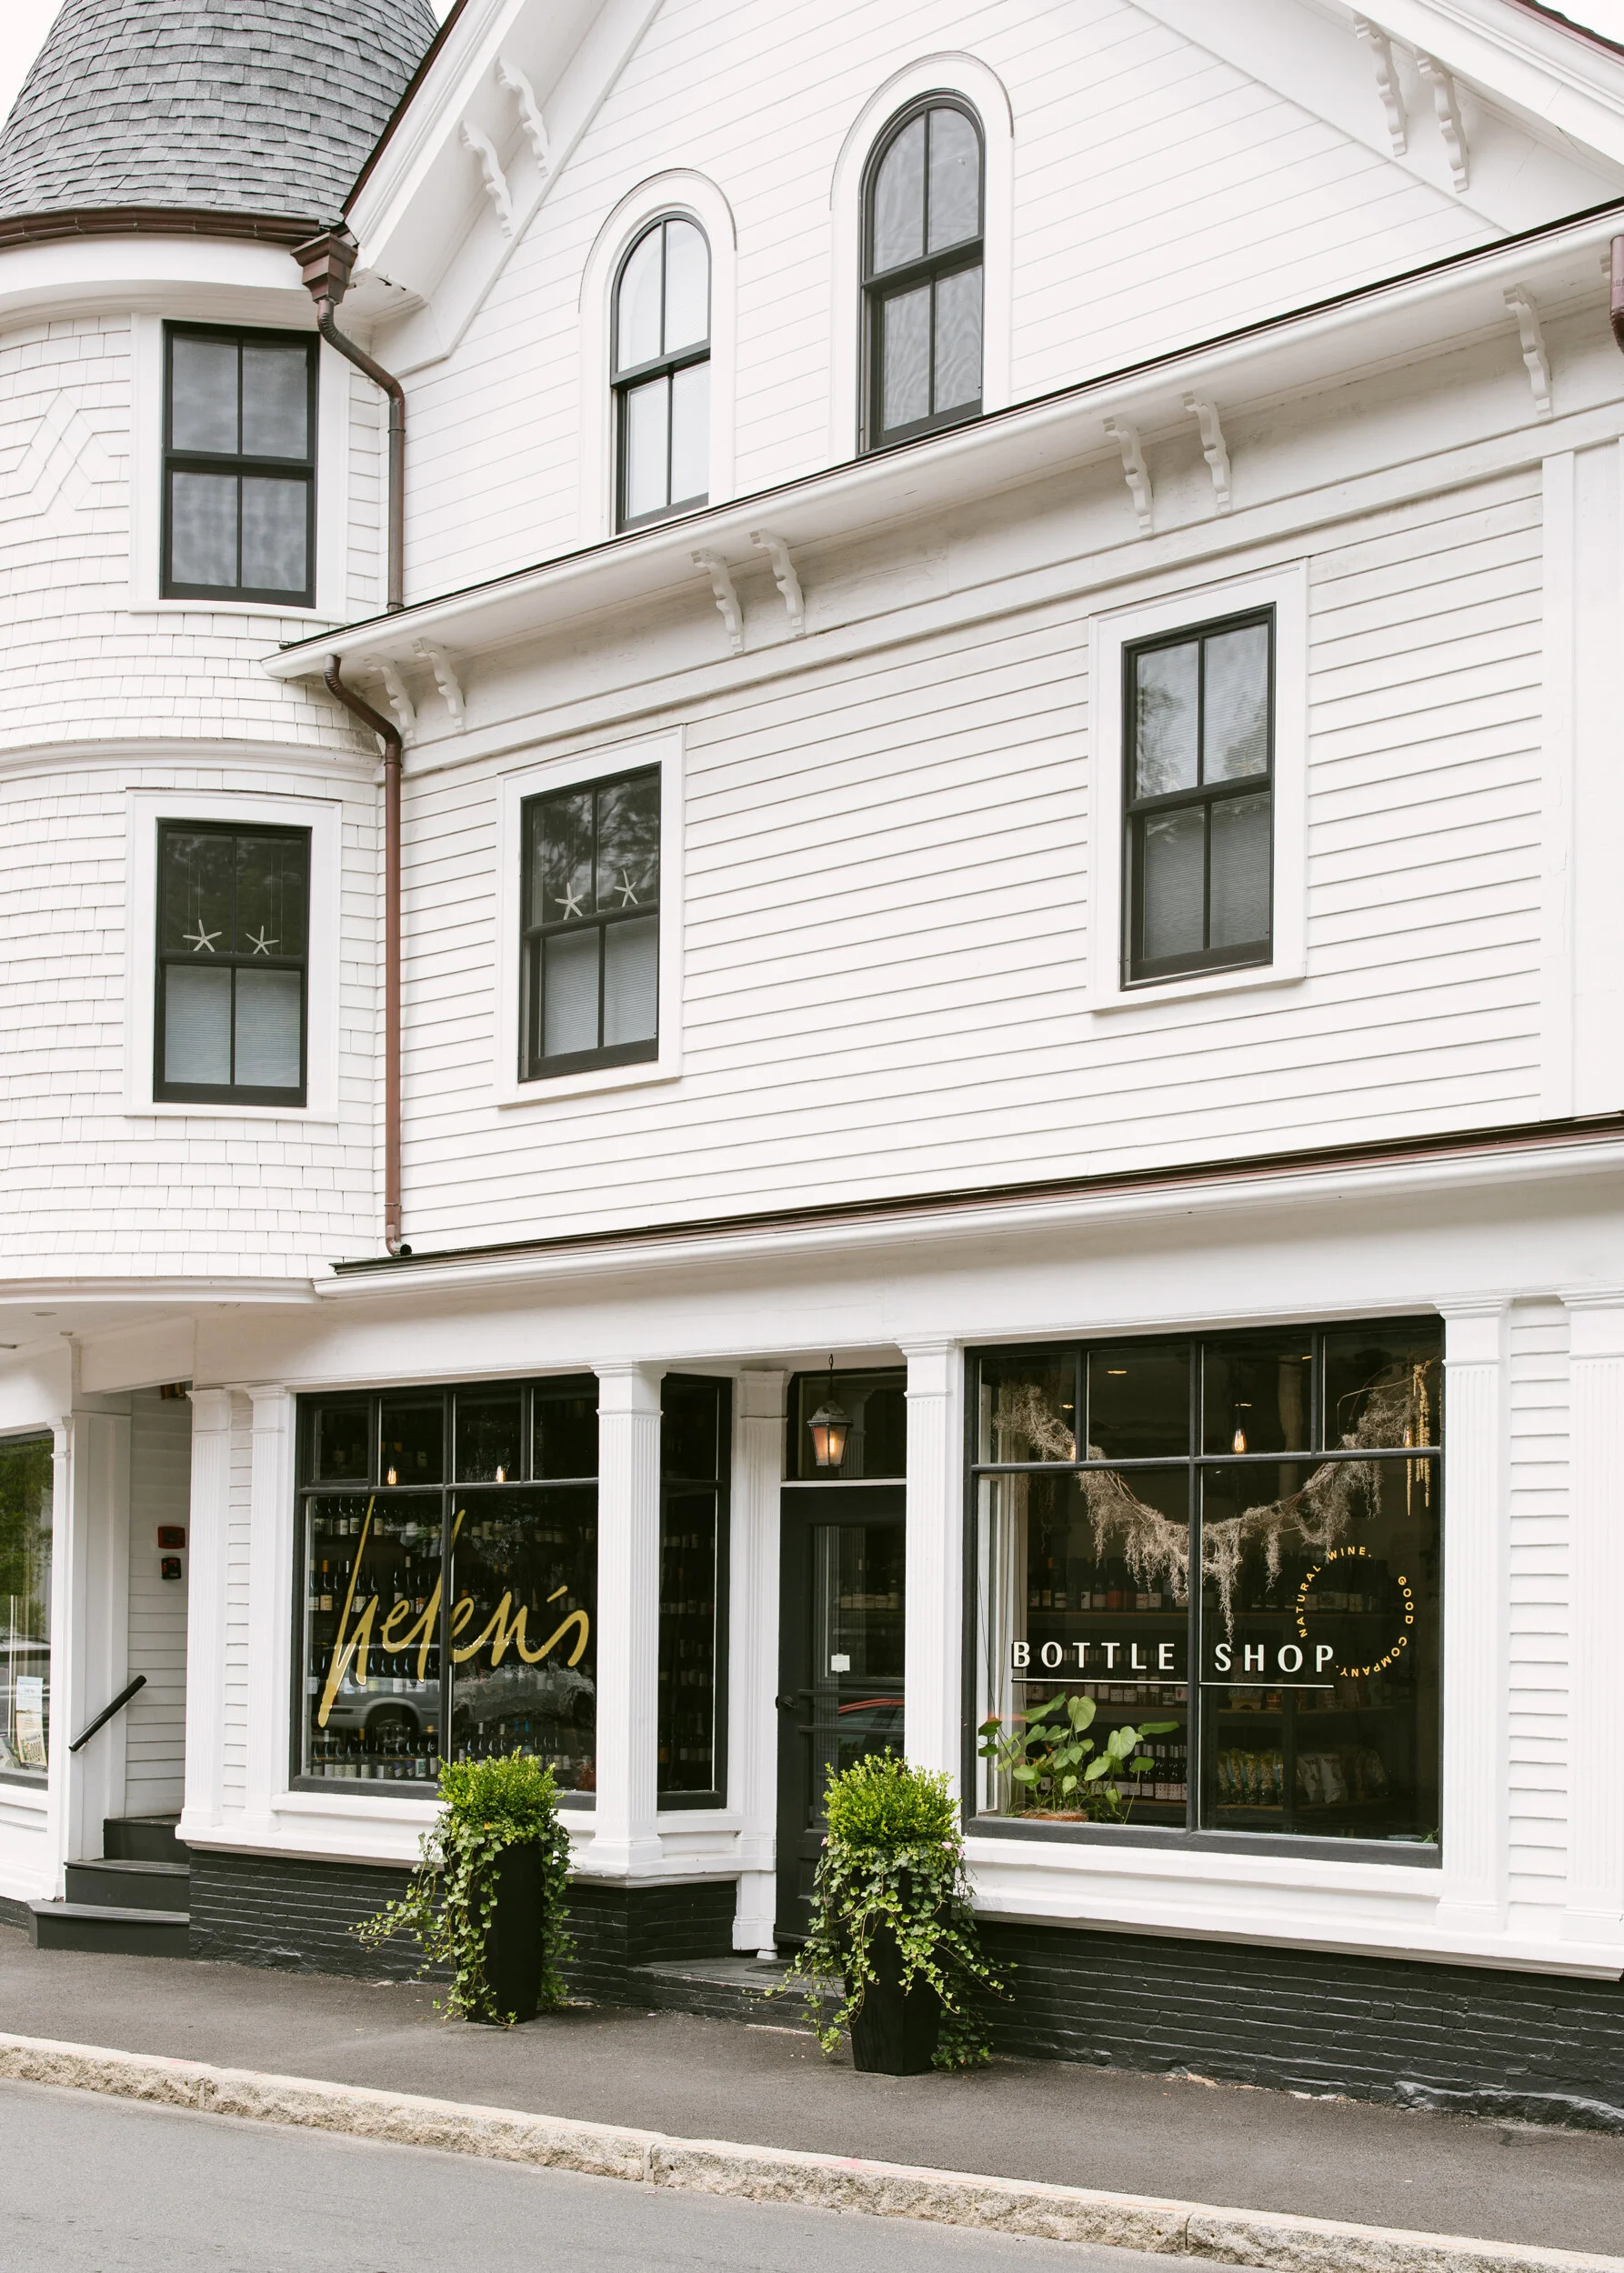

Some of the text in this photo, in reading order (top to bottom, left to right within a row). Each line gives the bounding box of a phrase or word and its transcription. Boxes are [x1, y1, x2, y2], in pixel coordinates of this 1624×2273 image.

[1296, 1547, 1371, 1638] NATURAL WINE.
[1336, 1576, 1414, 1677] GOOD COMPANY.
[1012, 1641, 1334, 1673] BOTTLE SHOP
